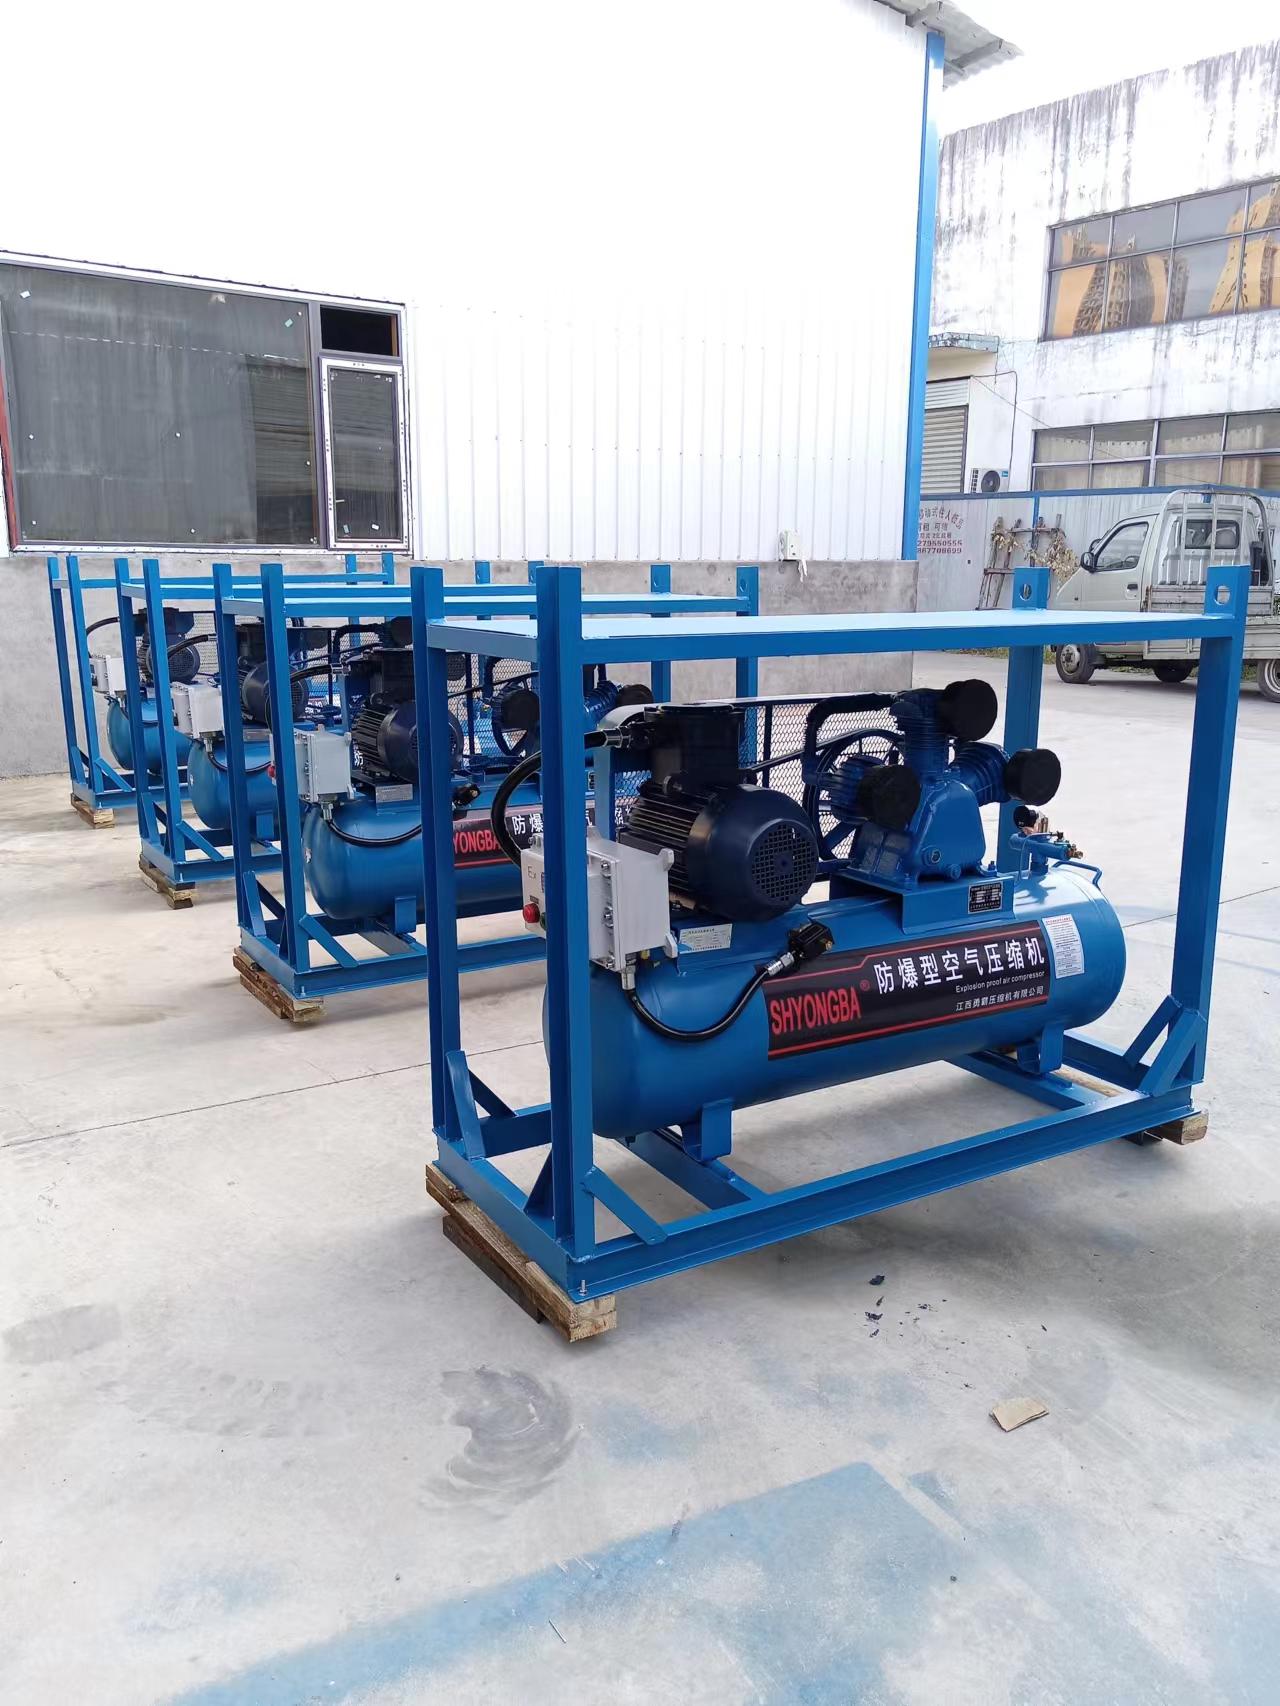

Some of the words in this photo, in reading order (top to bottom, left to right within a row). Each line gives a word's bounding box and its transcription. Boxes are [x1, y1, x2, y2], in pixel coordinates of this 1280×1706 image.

[874, 937, 1045, 995] 防爆型空气压缩机
[956, 981, 985, 993] Explosion
[986, 978, 1002, 989] proof
[1011, 971, 1045, 983] compressor
[770, 986, 862, 1035] SHYONGBA
